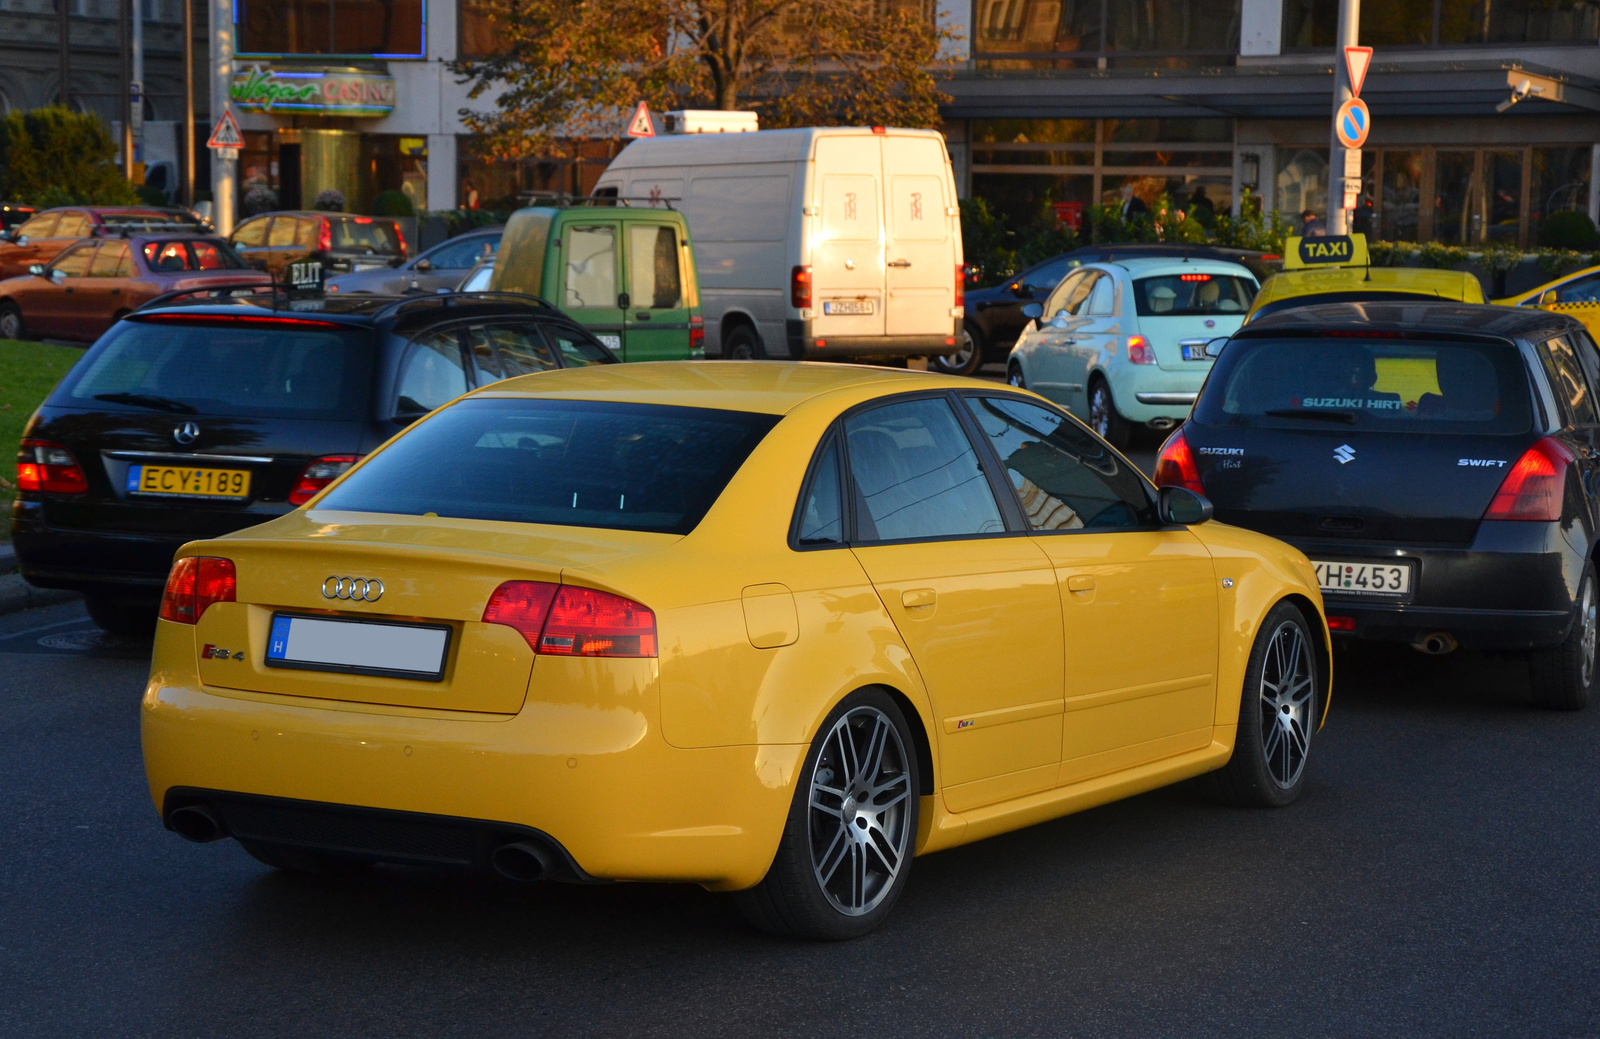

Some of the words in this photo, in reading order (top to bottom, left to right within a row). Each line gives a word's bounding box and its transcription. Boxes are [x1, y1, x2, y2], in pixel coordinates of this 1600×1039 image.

[323, 80, 393, 101] CASINO
[1304, 241, 1348, 257] TAXI
[291, 262, 321, 284] ELIT
[1303, 397, 1363, 408] SUZUKI
[1366, 399, 1403, 410] HIRT
[1199, 446, 1245, 456] SUZUKI
[1457, 458, 1508, 468] SWIFT
[273, 640, 284, 653] H
